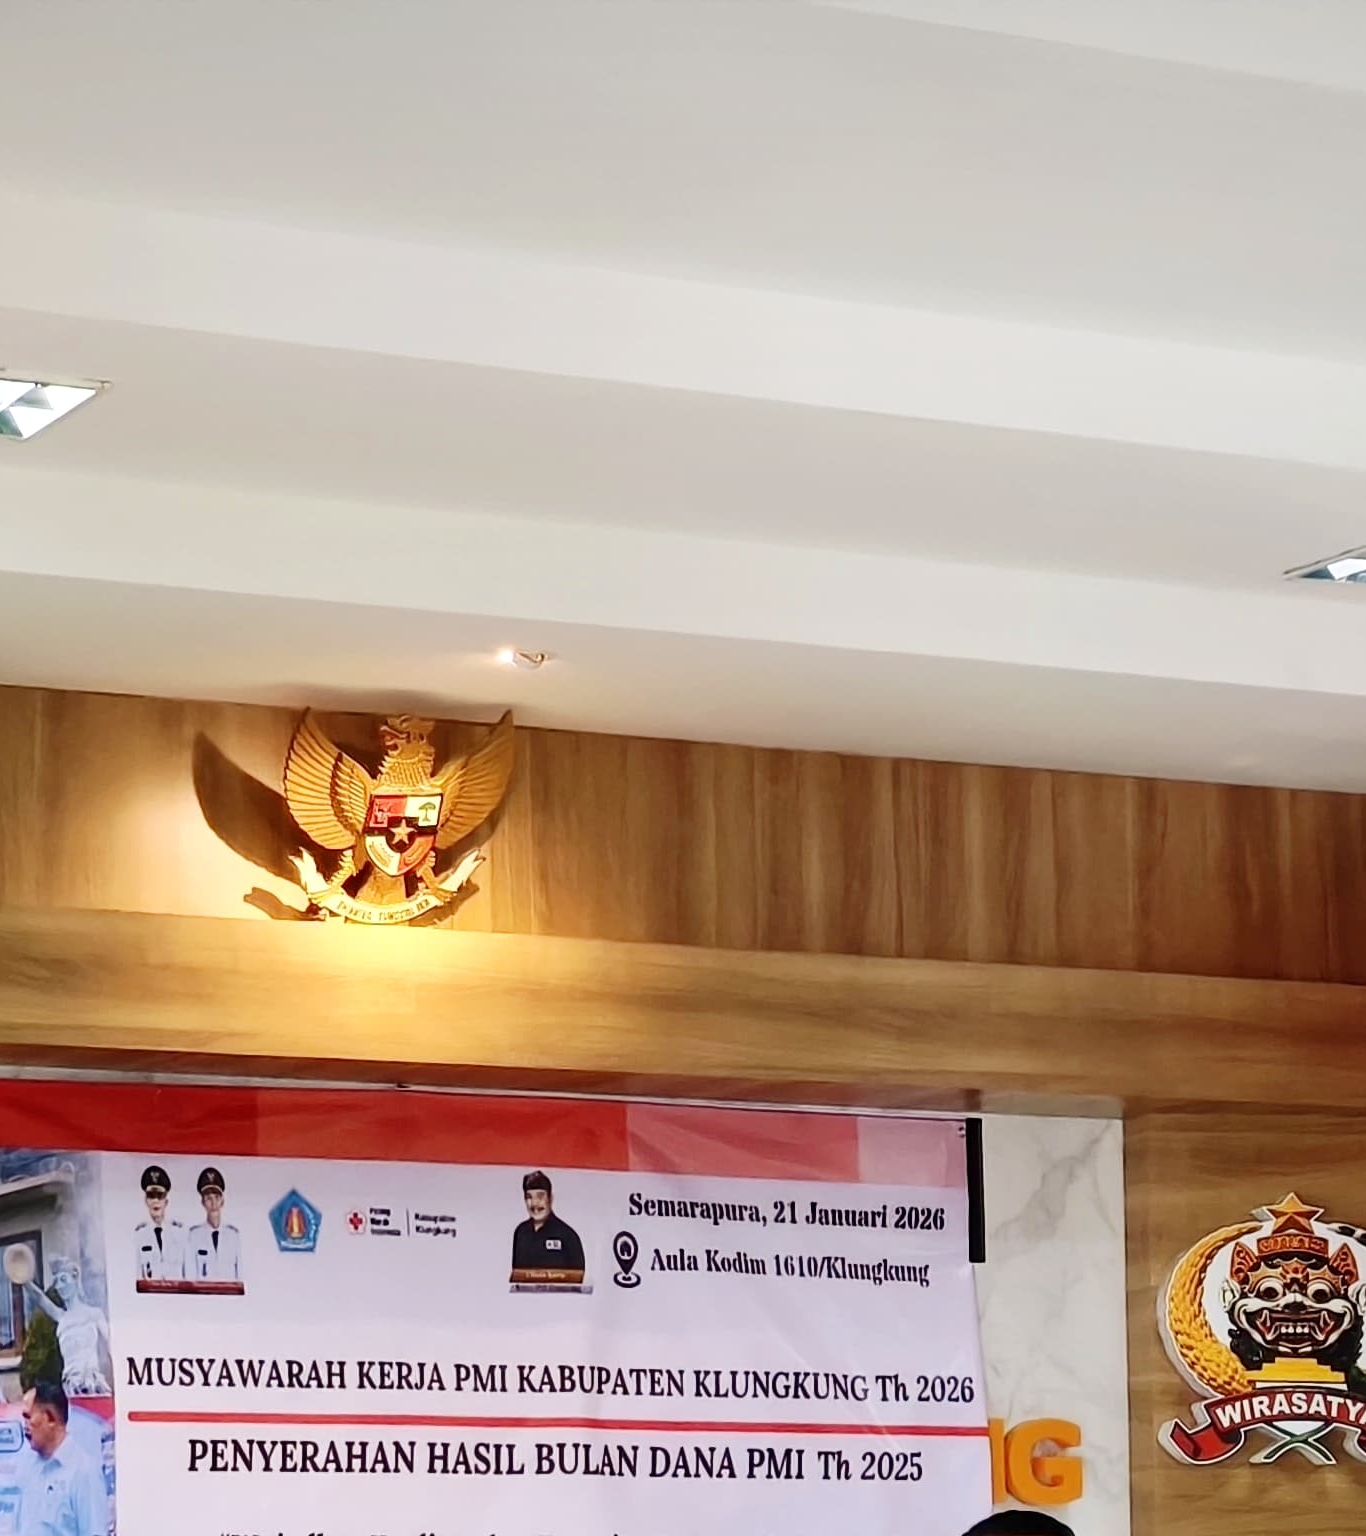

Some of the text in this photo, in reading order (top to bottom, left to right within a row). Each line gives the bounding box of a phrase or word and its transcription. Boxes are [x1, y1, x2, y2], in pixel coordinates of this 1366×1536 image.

[629, 1193, 944, 1230] Semarapura, 21 Januari 2026
[651, 1248, 929, 1287] Aula Kodim 1610/Klungkung
[127, 1357, 974, 1403] MUSYAWARAH KERJA PMI KABUPATEN KLUNGKUNG Th 2026
[188, 1439, 922, 1481] PENYERAHAN HASIL BULAN DANA PMI Th 2025
